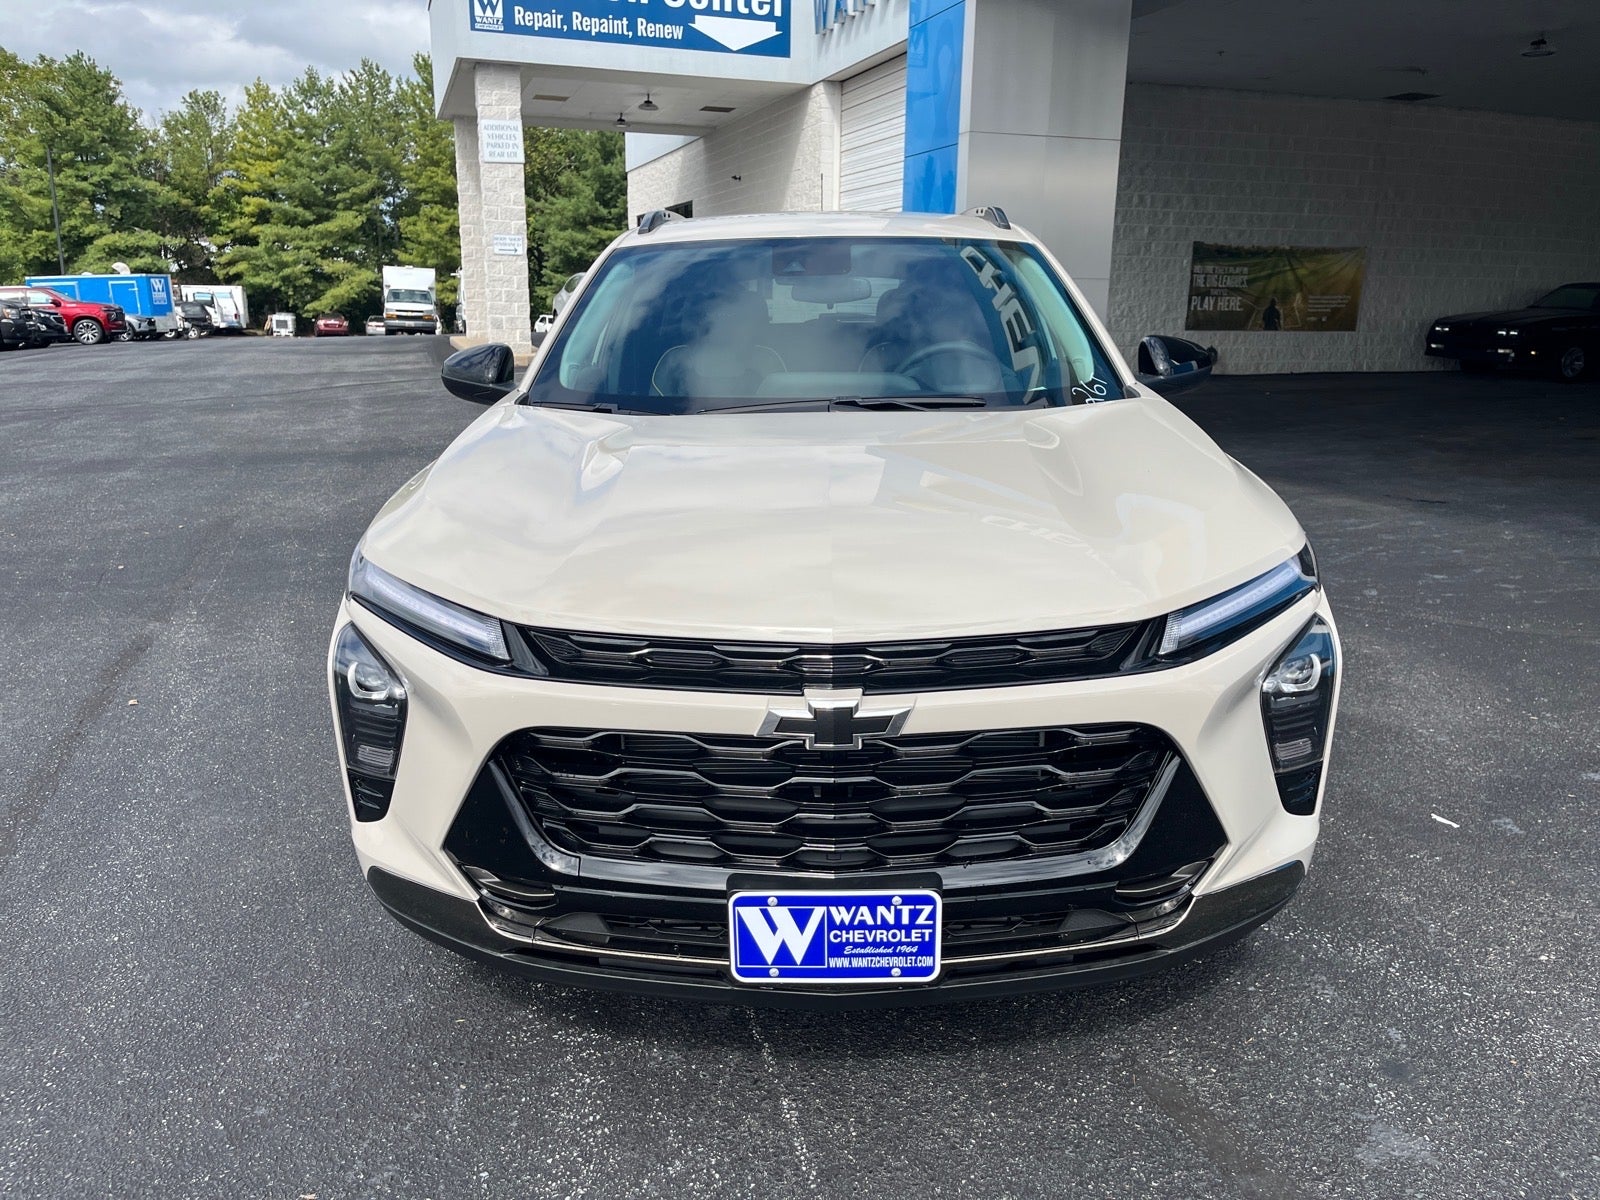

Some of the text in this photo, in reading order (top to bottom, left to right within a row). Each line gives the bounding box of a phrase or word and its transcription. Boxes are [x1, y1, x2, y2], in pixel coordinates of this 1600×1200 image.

[475, 16, 503, 25] WANTZ
[514, 6, 684, 40] Repair, Repaint, Renew
[483, 124, 519, 132] ADDITIONAL
[487, 133, 517, 141] VEHICLES
[1191, 297, 1216, 311] PLAY
[829, 905, 934, 926] WANTZ
[737, 907, 826, 966] W
[829, 929, 932, 943] CHEVROLET
[843, 945, 918, 955] Established 1964
[829, 956, 934, 968] WWW.WANTZCHEVROLET.COM
